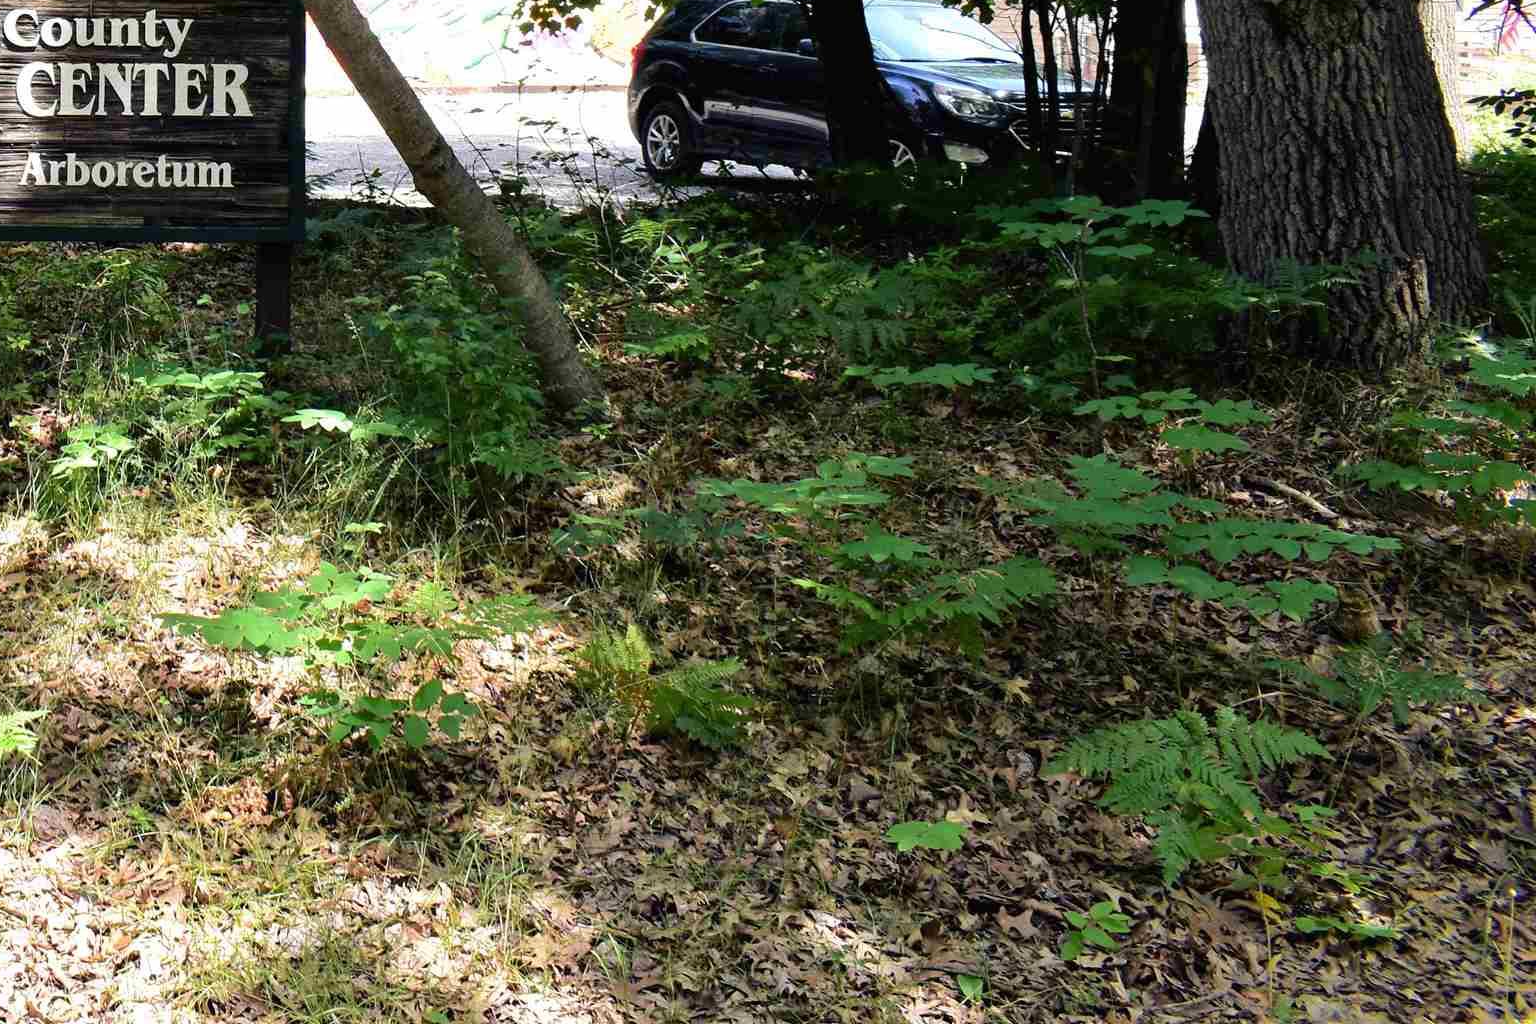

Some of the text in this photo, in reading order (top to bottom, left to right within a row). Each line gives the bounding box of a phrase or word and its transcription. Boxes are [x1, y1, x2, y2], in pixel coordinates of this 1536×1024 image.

[2, 8, 194, 57] County
[16, 62, 255, 117] CENTER
[19, 151, 234, 188] Arboretum
